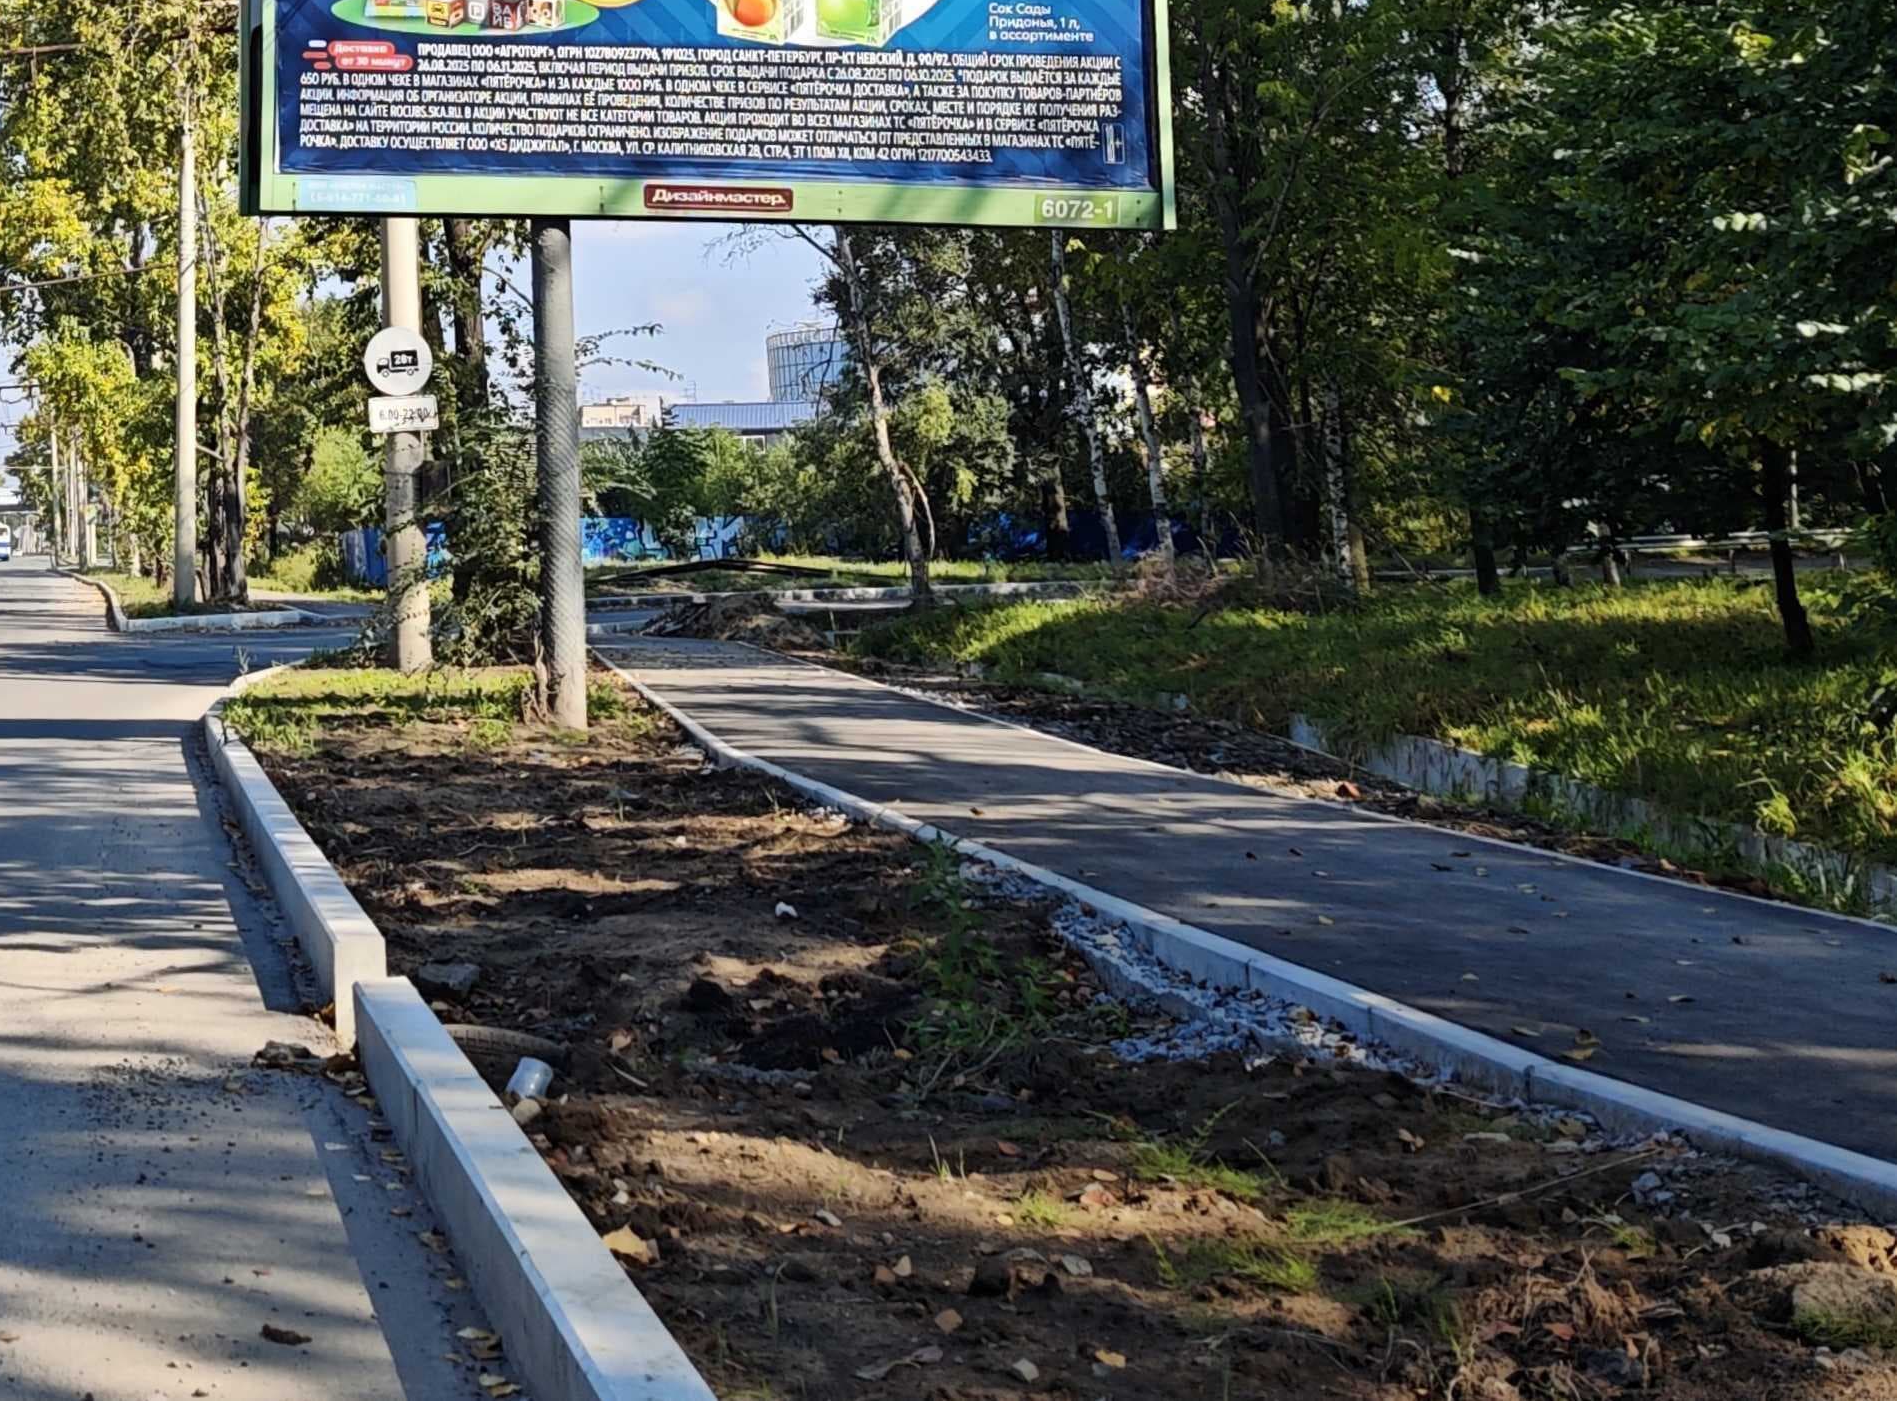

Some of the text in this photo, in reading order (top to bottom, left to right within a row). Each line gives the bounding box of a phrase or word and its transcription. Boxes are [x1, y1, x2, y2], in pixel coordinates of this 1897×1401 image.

[988, 2, 1051, 15] Сок Сады
[988, 15, 1057, 29] Придонья,
[1059, 17, 1065, 28] 1
[334, 44, 388, 54] Доставка
[988, 30, 1094, 43] в ассортименте
[417, 43, 470, 58] ПРОДАВЕЦ
[471, 44, 493, 57] ООО
[557, 46, 582, 58] ОГРН
[697, 49, 731, 63] ГОРОД
[732, 49, 823, 64] САНКТ-ПЕТЕРБУРГ,
[825, 51, 855, 64] ПР-КТ
[856, 50, 905, 66] НЕВСКИЙ,
[951, 52, 988, 67] ОБЩИЙ
[989, 54, 1013, 67] СРОК
[1015, 54, 1078, 69] ПРОВЕДЕНИЯ
[1080, 56, 1113, 70] АКЦИИ
[417, 59, 468, 72] 26.08.2025
[471, 60, 484, 72] ПО
[538, 61, 585, 74] ВКЛЮЧАЯ
[587, 62, 625, 76] ПЕРИОД
[627, 63, 667, 77] ВЫДАЧИ
[669, 64, 710, 77] ПРИЗОВ.
[710, 64, 734, 77] СРОК
[737, 65, 777, 79] ВЫДАЧИ
[779, 66, 825, 80] ПОДАРКА
[835, 67, 886, 80] 26.08.2025
[888, 68, 902, 80] ПО
[1010, 69, 1062, 85] ВЫДАЁТСЯ
[1065, 71, 1075, 84] ЗА
[1077, 72, 1120, 86] КАЖДЫЕ
[299, 72, 1122, 100] 650 РУБ. ОДНОМ ЧЕКЕ МАГАЗИНАХ «ПЯТЁРОЧКА» ЗА КАЖДЫЕ 1000 РУБ. ОДНОМ ЧЕКЕ СЕРВИСЕ «ПЯТЁРОЧКА ДОСТАВКА», ТАКЖЕ ЗА ПОКУПКУ ТОВАРОВ-ПАРТНЁРОВ
[299, 87, 1121, 116] АКЦИИ. ИНФОРМАЦИЯ ОРГАНИЗАТОРЕ АКЦИИ, ПРАВИЛАХ ПРОВЕДЕНИЯ, КОЛИЧЕСТВЕ ПРИЗОВ ПО РЕЗУЛЬТАТАМ АКЦИИ, СРОКАХ, МЕСТЕ ПОРЯДКЕ ПОЛУЧЕНИЯ РАЗ-
[299, 103, 341, 117] МЕЩЕНА
[343, 104, 356, 116] НА
[358, 103, 387, 117] САЙТЕ
[472, 107, 505, 121] АКЦИИ
[507, 107, 563, 121] УЧАСТВУЮТ
[566, 109, 578, 121] НЕ
[580, 109, 597, 121] ВСЕ
[599, 109, 654, 122] КАТЕГОРИИ
[656, 110, 703, 123] ТОВАРОВ.
[704, 111, 736, 125] АКЦИЯ
[738, 112, 789, 127] ПРОХОДИТ
[791, 113, 805, 126] ВО
[807, 114, 830, 126] ВСЕХ
[833, 114, 891, 127] МАГАЗИНАХ
[907, 114, 974, 129] «ПЯТЁРОЧКА»
[994, 117, 1034, 130] СЕРВИСЕ
[1038, 117, 1098, 132] «ПЯТЁРОЧКА
[299, 118, 354, 133] ДОСТАВКА»
[355, 120, 369, 132] НА
[370, 120, 430, 133] ТЕРРИТОРИИ
[431, 121, 472, 134] РОССИИ.
[472, 122, 534, 136] КОЛИЧЕСТВО
[535, 123, 586, 138] ПОДАРКОВ
[587, 125, 652, 138] ОГРАНИЧЕНО.
[653, 126, 722, 140] ИЗОБРАЖЕНИЕ
[725, 128, 776, 142] ПОДАРКОВ
[777, 129, 813, 142] МОЖЕТ
[815, 129, 877, 143] ОТЛИЧАТЬСЯ
[893, 131, 981, 146] ПРЕДСТАВЛЕННЫХ
[991, 133, 1049, 147] МАГАЗИНАХ
[340, 135, 388, 149] ДОСТАВКУ
[390, 136, 464, 151] ОСУЩЕСТВЛЯЕТ
[466, 138, 488, 150] ООО
[581, 140, 624, 154] МОСКВА,
[890, 147, 915, 159] ОГРН
[1041, 199, 1113, 219] 6072-1
